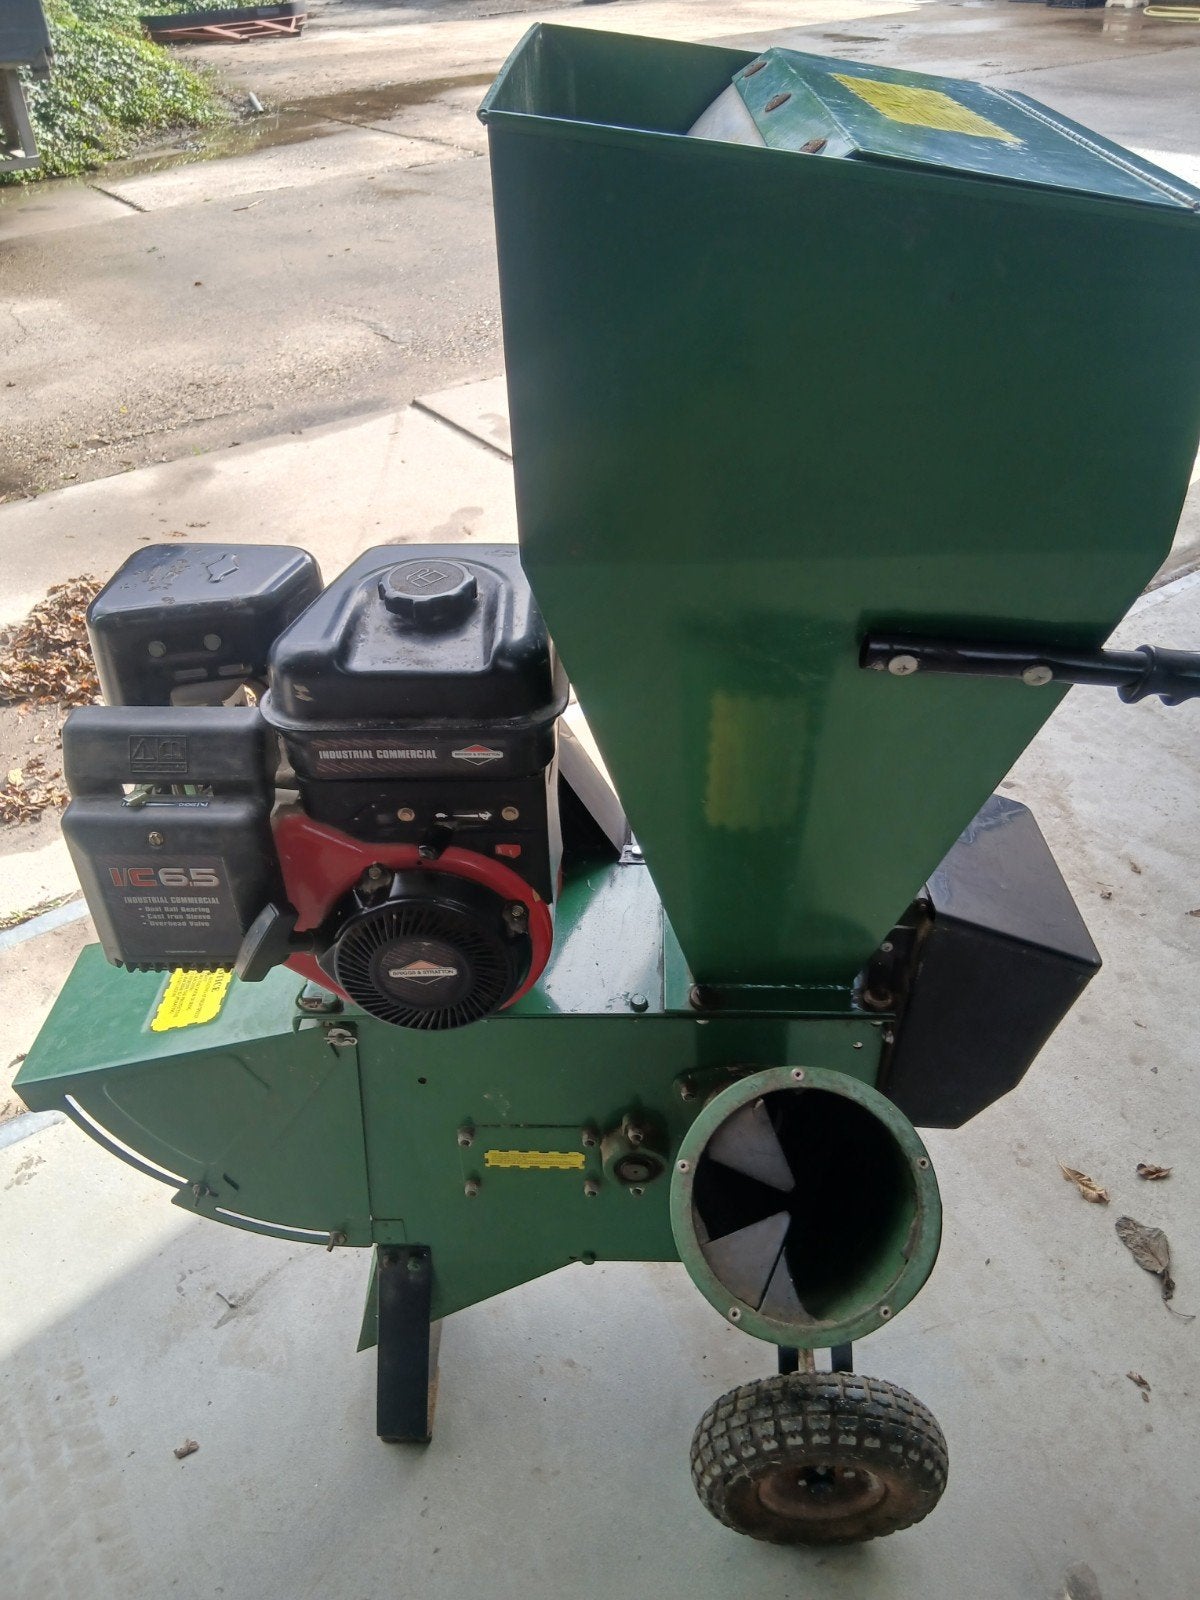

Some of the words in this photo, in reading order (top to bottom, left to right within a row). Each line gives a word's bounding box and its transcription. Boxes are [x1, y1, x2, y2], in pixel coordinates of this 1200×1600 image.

[319, 750, 374, 759] INDUSTRIAL
[376, 749, 437, 759] COMMERCIAL
[124, 896, 168, 904] INDUSTRIAL
[170, 896, 220, 904] COMMERCIAL
